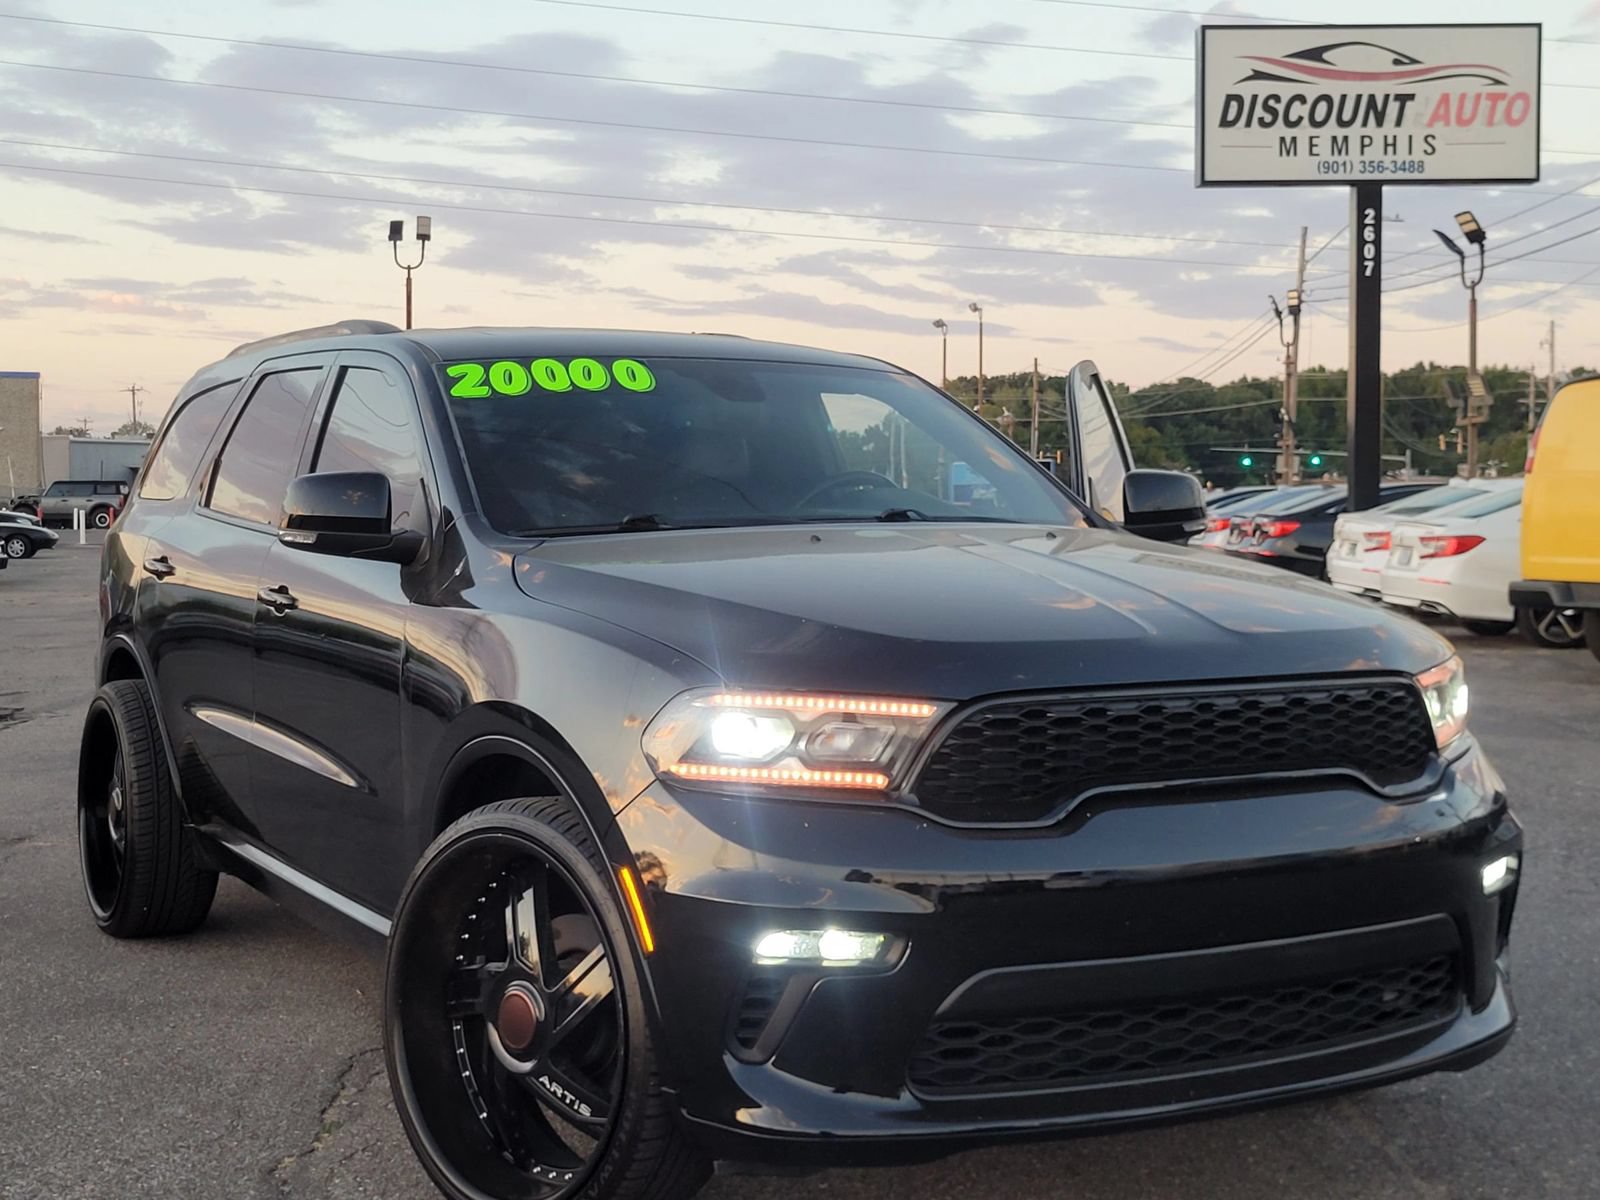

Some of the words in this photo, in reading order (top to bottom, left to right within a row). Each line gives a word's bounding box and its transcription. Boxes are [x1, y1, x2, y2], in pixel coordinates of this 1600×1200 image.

[1218, 93, 1416, 129] DISCOUNT
[1426, 91, 1532, 129] AUTO
[1278, 134, 1437, 157] MEMPHIS
[1317, 160, 1354, 175] (901)
[1358, 159, 1425, 175] 356-3488
[1363, 208, 1377, 278] 2607
[446, 357, 657, 399] 20000
[538, 1075, 592, 1117] ARTIS
